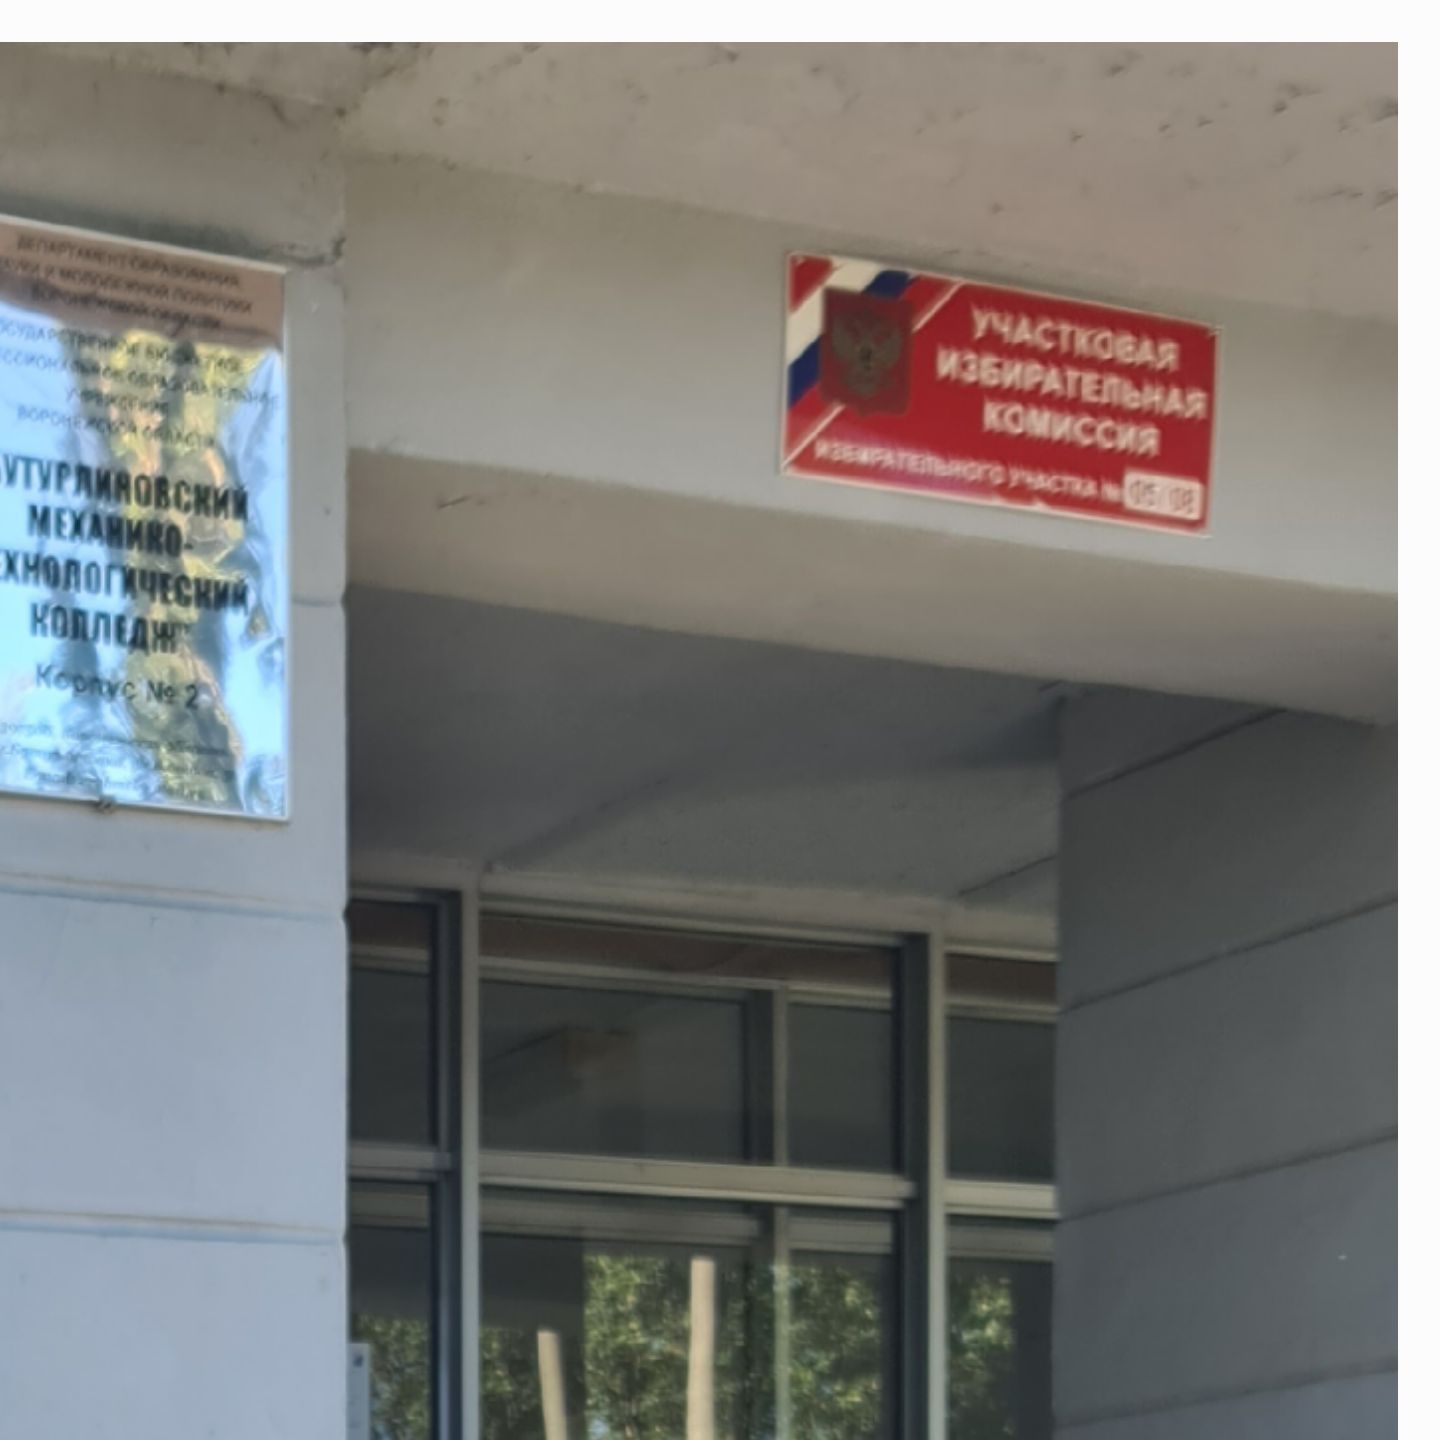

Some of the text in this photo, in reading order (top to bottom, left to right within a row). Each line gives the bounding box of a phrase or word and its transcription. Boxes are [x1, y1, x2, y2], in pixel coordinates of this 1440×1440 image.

[971, 307, 1180, 372] УЧАСТКОВАЯ
[936, 345, 1207, 420] ИЗБИРАТЕЛЬНАЯ
[984, 401, 1162, 457] КОМИССИЯ
[814, 440, 1006, 486] ИЗБИРАТЕЛЬНОГО
[1009, 464, 1098, 498] УЧАСТКА
[26, 503, 193, 556] МЕХАНИКО-
[35, 663, 136, 698] Корпус
[184, 683, 198, 707] 2
